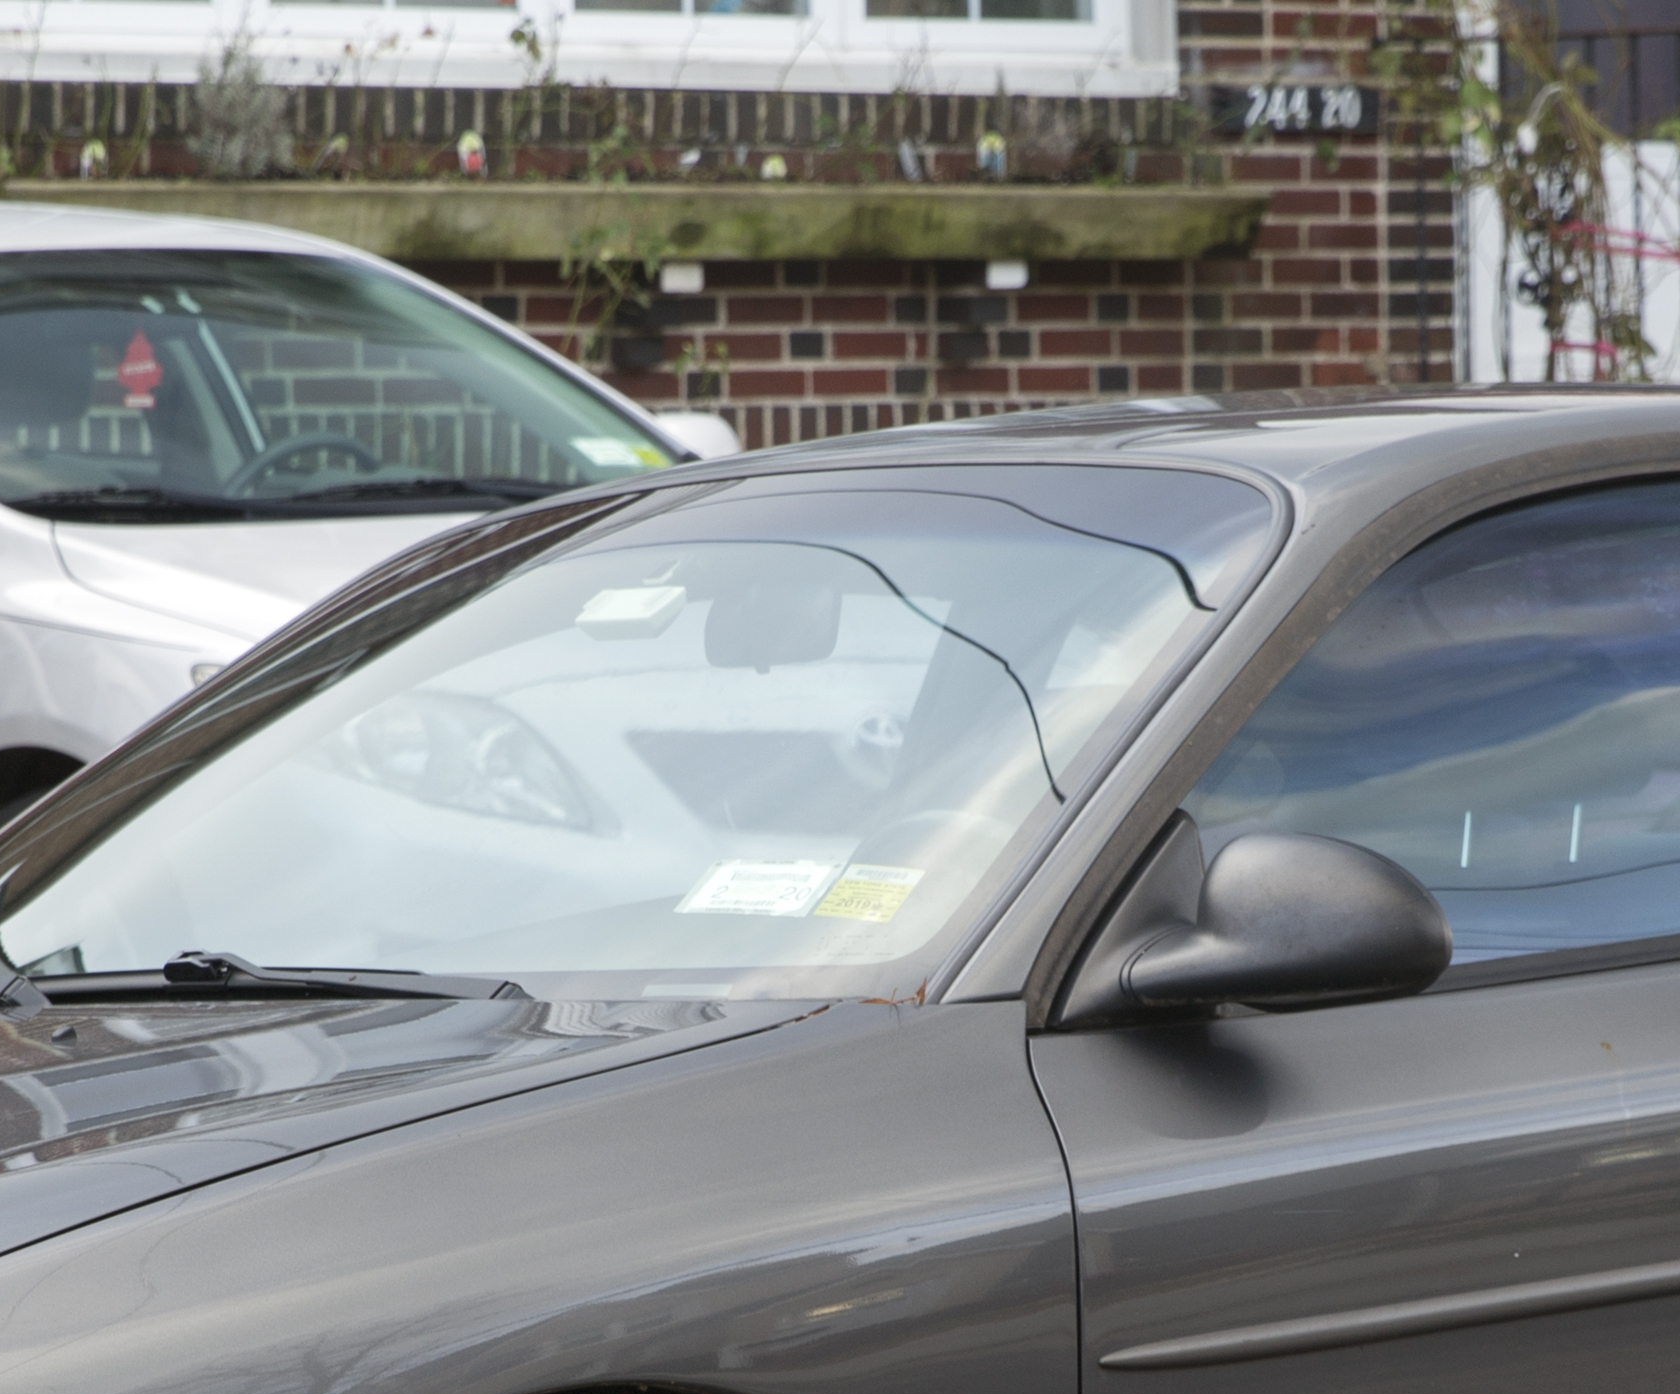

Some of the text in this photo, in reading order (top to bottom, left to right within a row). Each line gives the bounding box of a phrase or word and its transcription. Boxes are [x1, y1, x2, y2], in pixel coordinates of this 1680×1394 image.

[710, 885, 812, 901] 2 20
[835, 898, 871, 909] 2019
